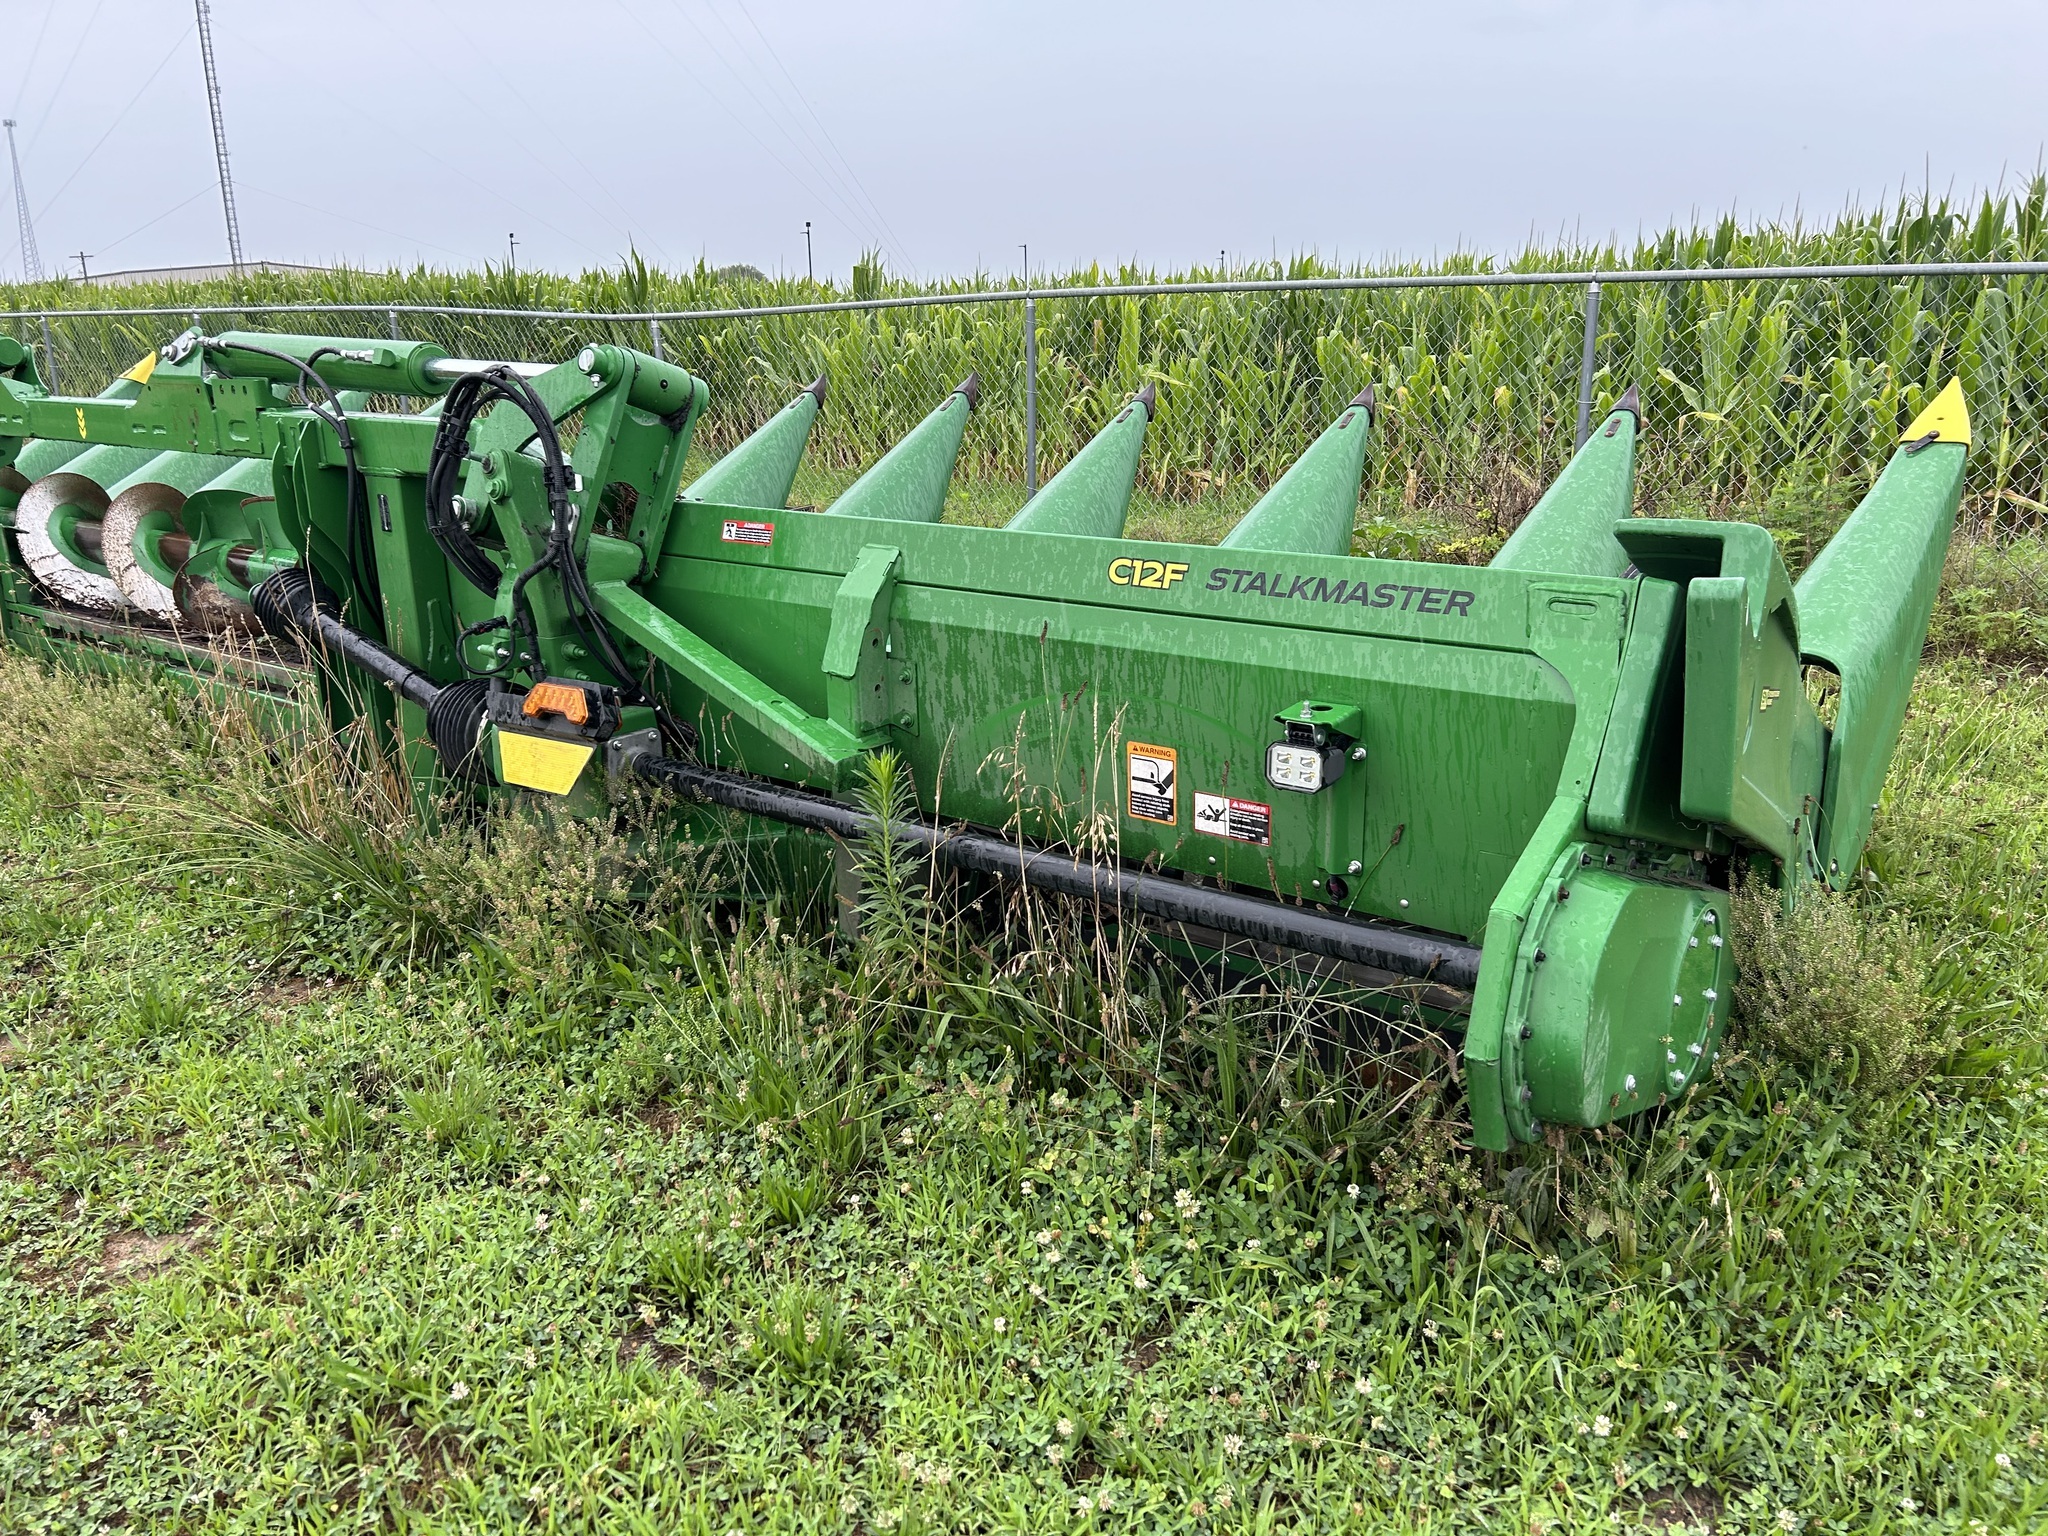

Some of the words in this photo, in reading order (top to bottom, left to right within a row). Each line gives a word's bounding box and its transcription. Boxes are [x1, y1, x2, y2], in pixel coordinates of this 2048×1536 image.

[1107, 557, 1189, 590] C12F
[1205, 567, 1475, 617] STALKMASTER
[1139, 745, 1171, 758] WARNING
[1239, 802, 1266, 813] DANGER
